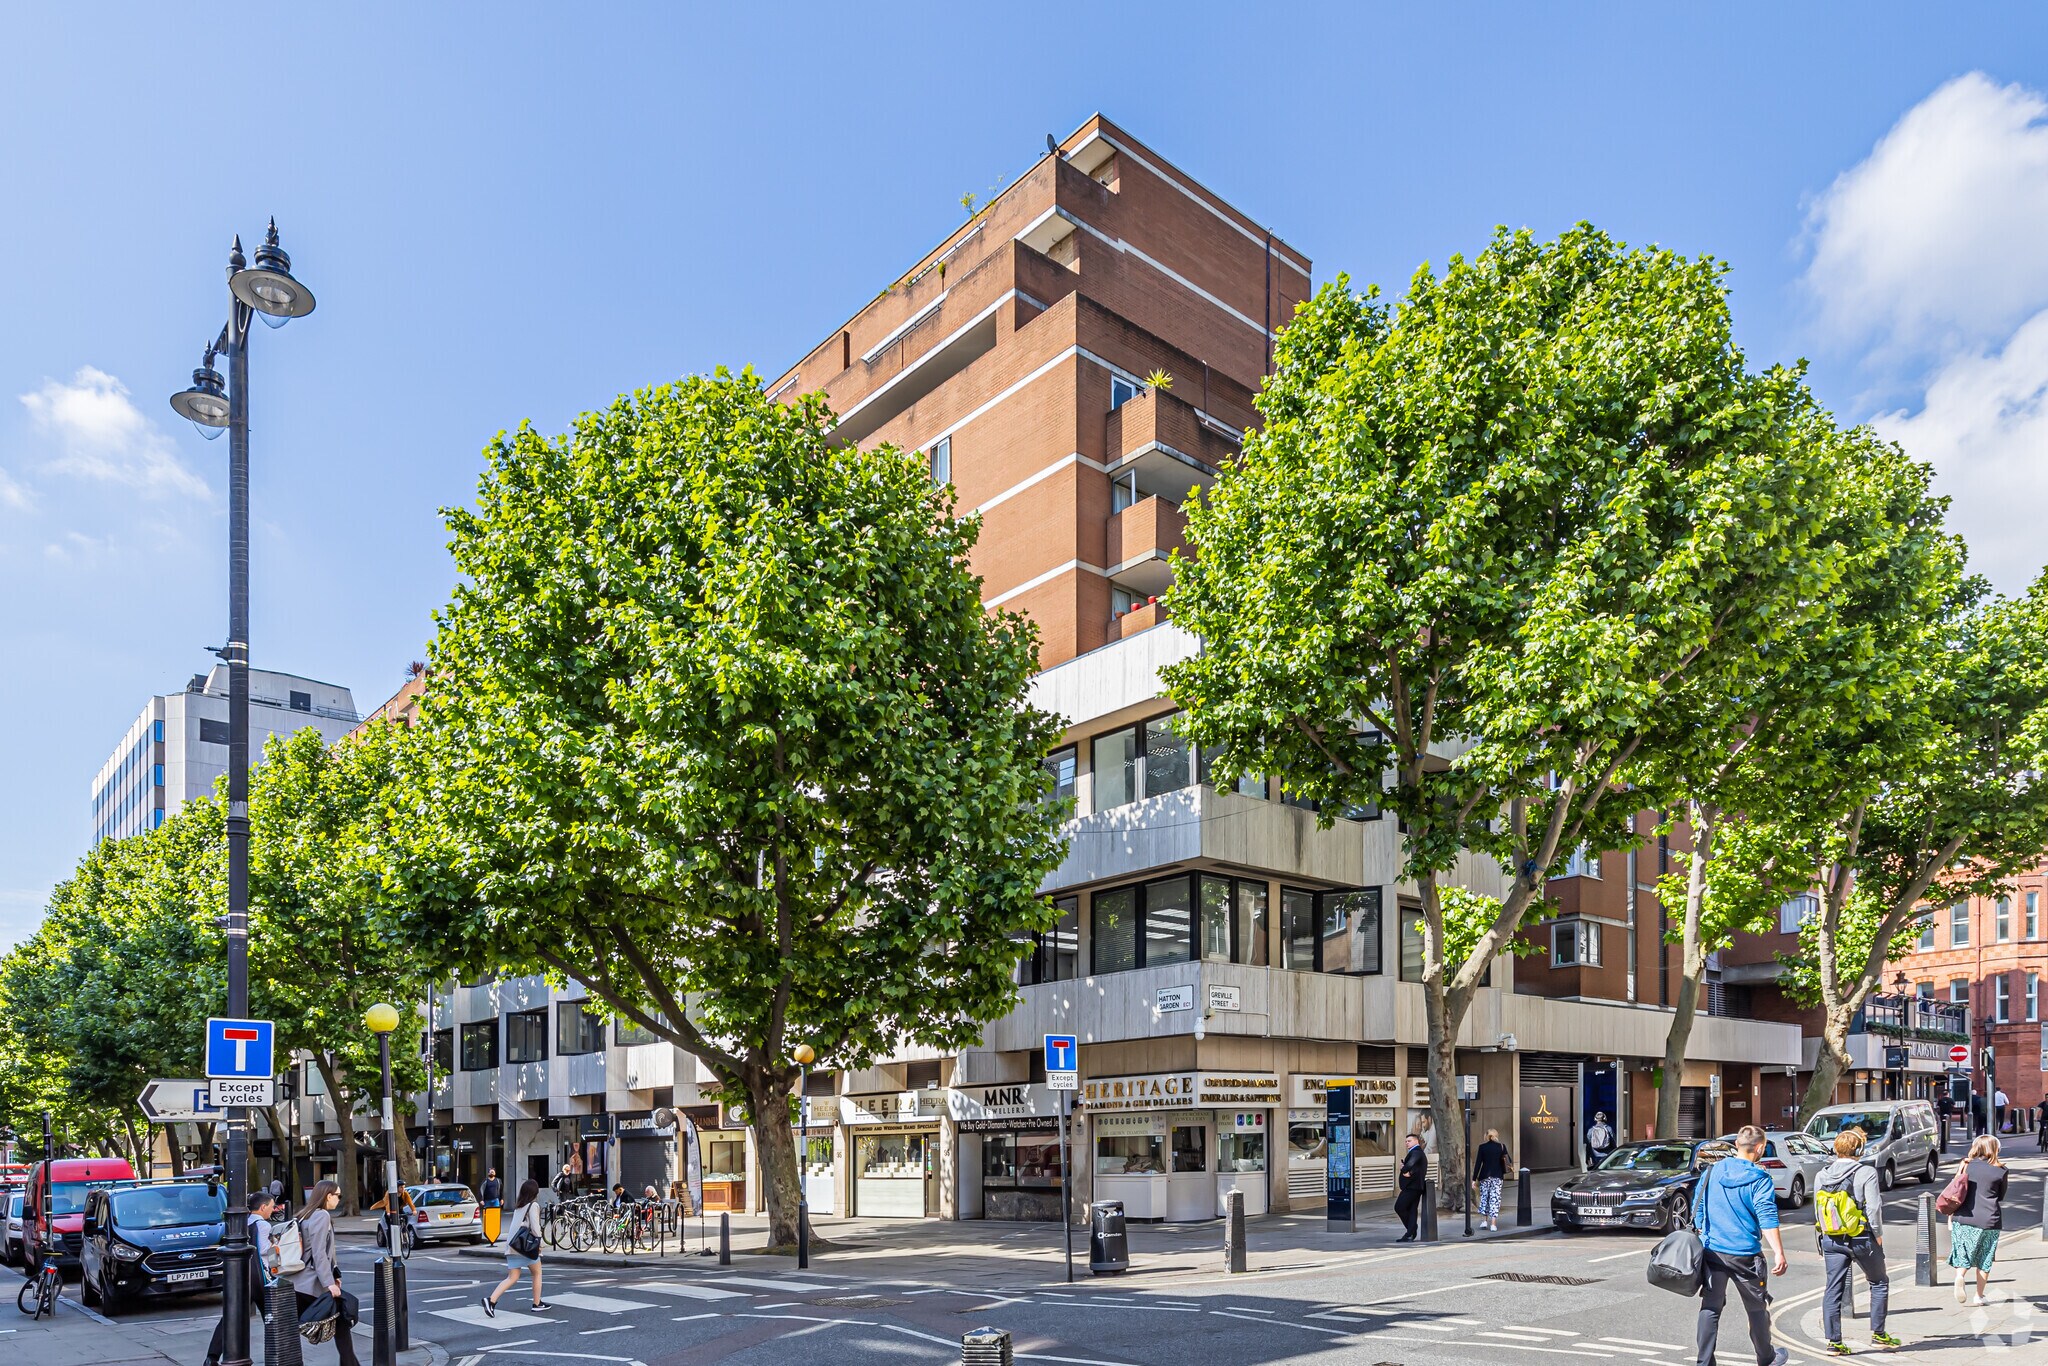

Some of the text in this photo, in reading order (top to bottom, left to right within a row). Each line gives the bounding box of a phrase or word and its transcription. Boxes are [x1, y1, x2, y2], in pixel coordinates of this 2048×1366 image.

[1158, 994, 1181, 1003] HATTON
[1211, 992, 1232, 1000] GREVILLE
[1159, 1002, 1180, 1010] GARDEN
[1917, 1044, 1939, 1058] ARGYLE
[1051, 1074, 1074, 1082] Except
[219, 1082, 265, 1093] Except
[1052, 1081, 1073, 1089] cycles
[1085, 1077, 1194, 1100] HERITAGE
[221, 1094, 263, 1104] cycles
[920, 1097, 947, 1105] HEERA
[984, 1087, 1025, 1107] MNR
[1200, 1094, 1239, 1102] EMERALDS
[1359, 1093, 1388, 1105] BANDS
[855, 1097, 917, 1112] HEERA
[1085, 1097, 1193, 1110] DIAMOND & GEM DEALERS
[985, 1106, 1025, 1116] JEWELLERS
[960, 1121, 967, 1131] We
[1037, 1117, 1053, 1128] Owned
[171, 1273, 189, 1281] LP71
